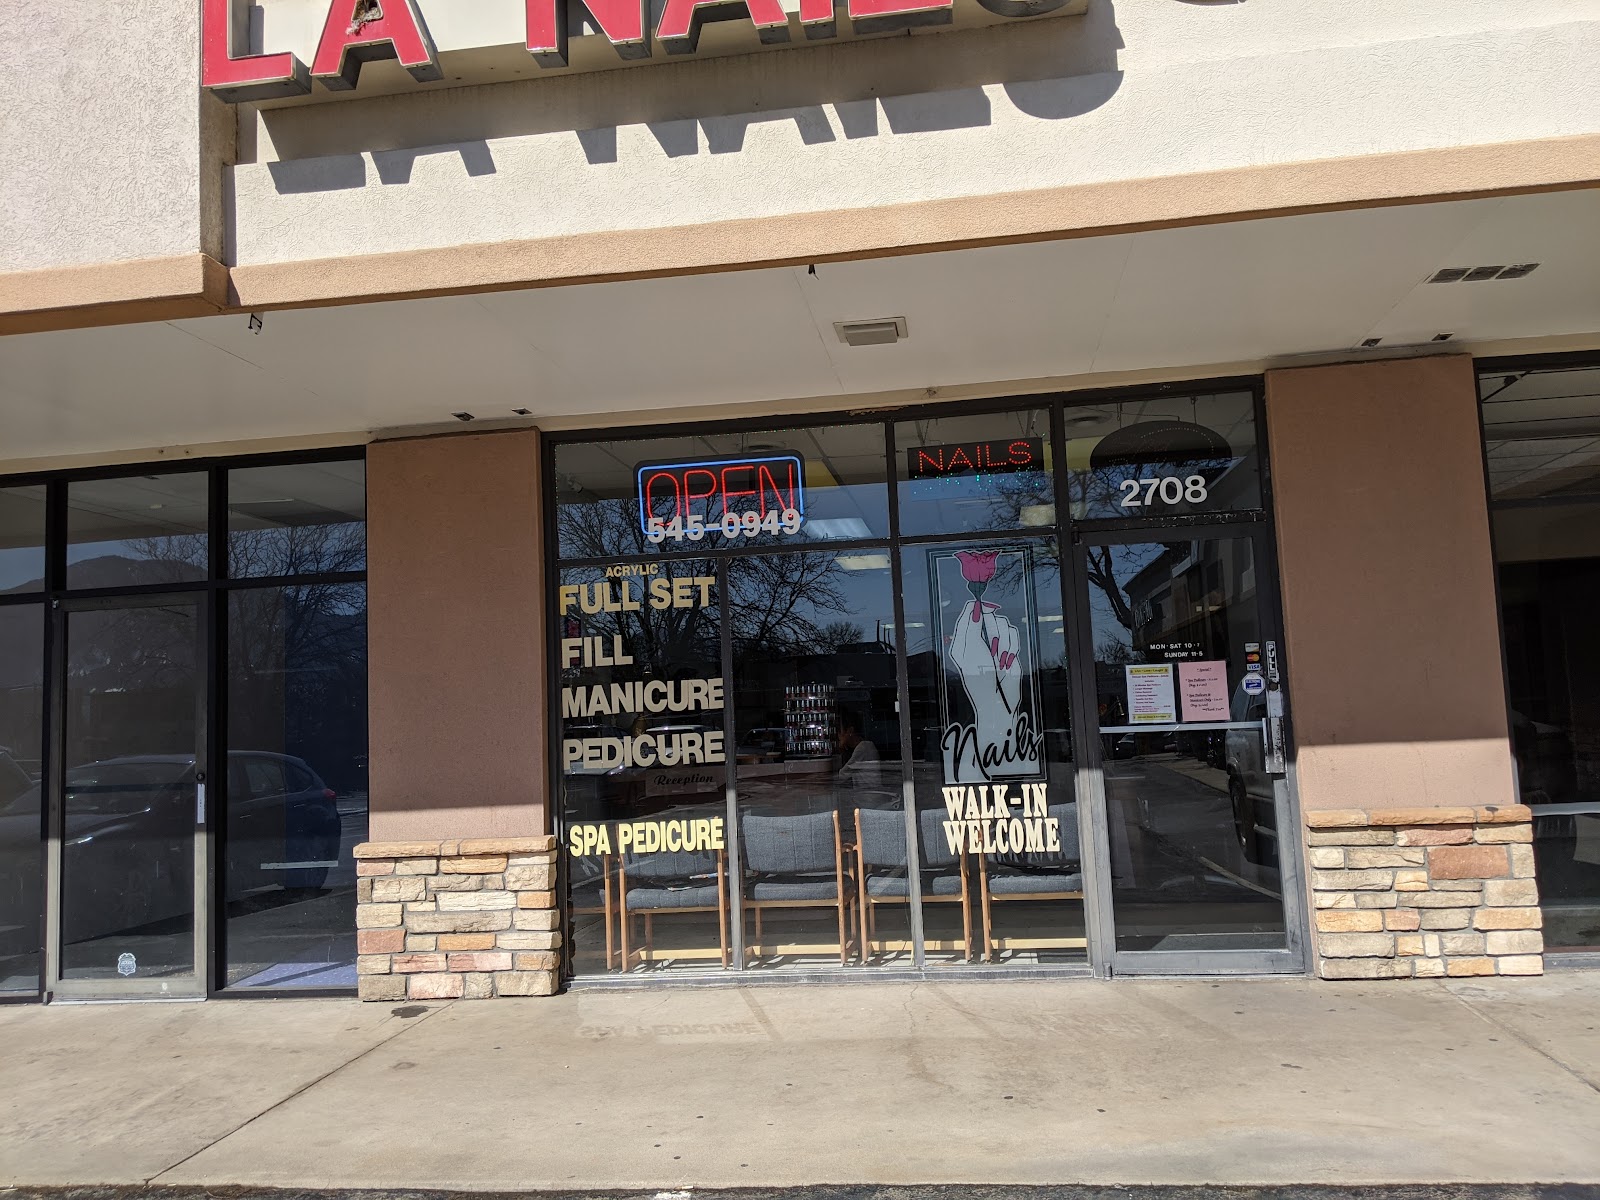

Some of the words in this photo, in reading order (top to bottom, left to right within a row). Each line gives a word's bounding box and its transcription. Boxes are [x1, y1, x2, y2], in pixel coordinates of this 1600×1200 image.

[919, 441, 1032, 472] NAILS
[646, 464, 794, 526] OPEN
[1119, 475, 1208, 507] 2708
[647, 508, 801, 543] 545-0949
[605, 563, 659, 577] ACRYLIC
[559, 581, 640, 615] FULL
[649, 577, 715, 610] SET
[561, 635, 634, 669] FILL
[1267, 644, 1276, 671] PULL
[561, 678, 725, 719] MANICURE
[563, 731, 726, 770] PEDICURE
[941, 712, 1043, 783] Nails
[653, 773, 714, 786] Reception
[942, 783, 1048, 821] WALK-IN
[569, 824, 611, 857] SPA
[618, 818, 725, 854] PEDICURE
[942, 818, 1060, 855] WELCOME
